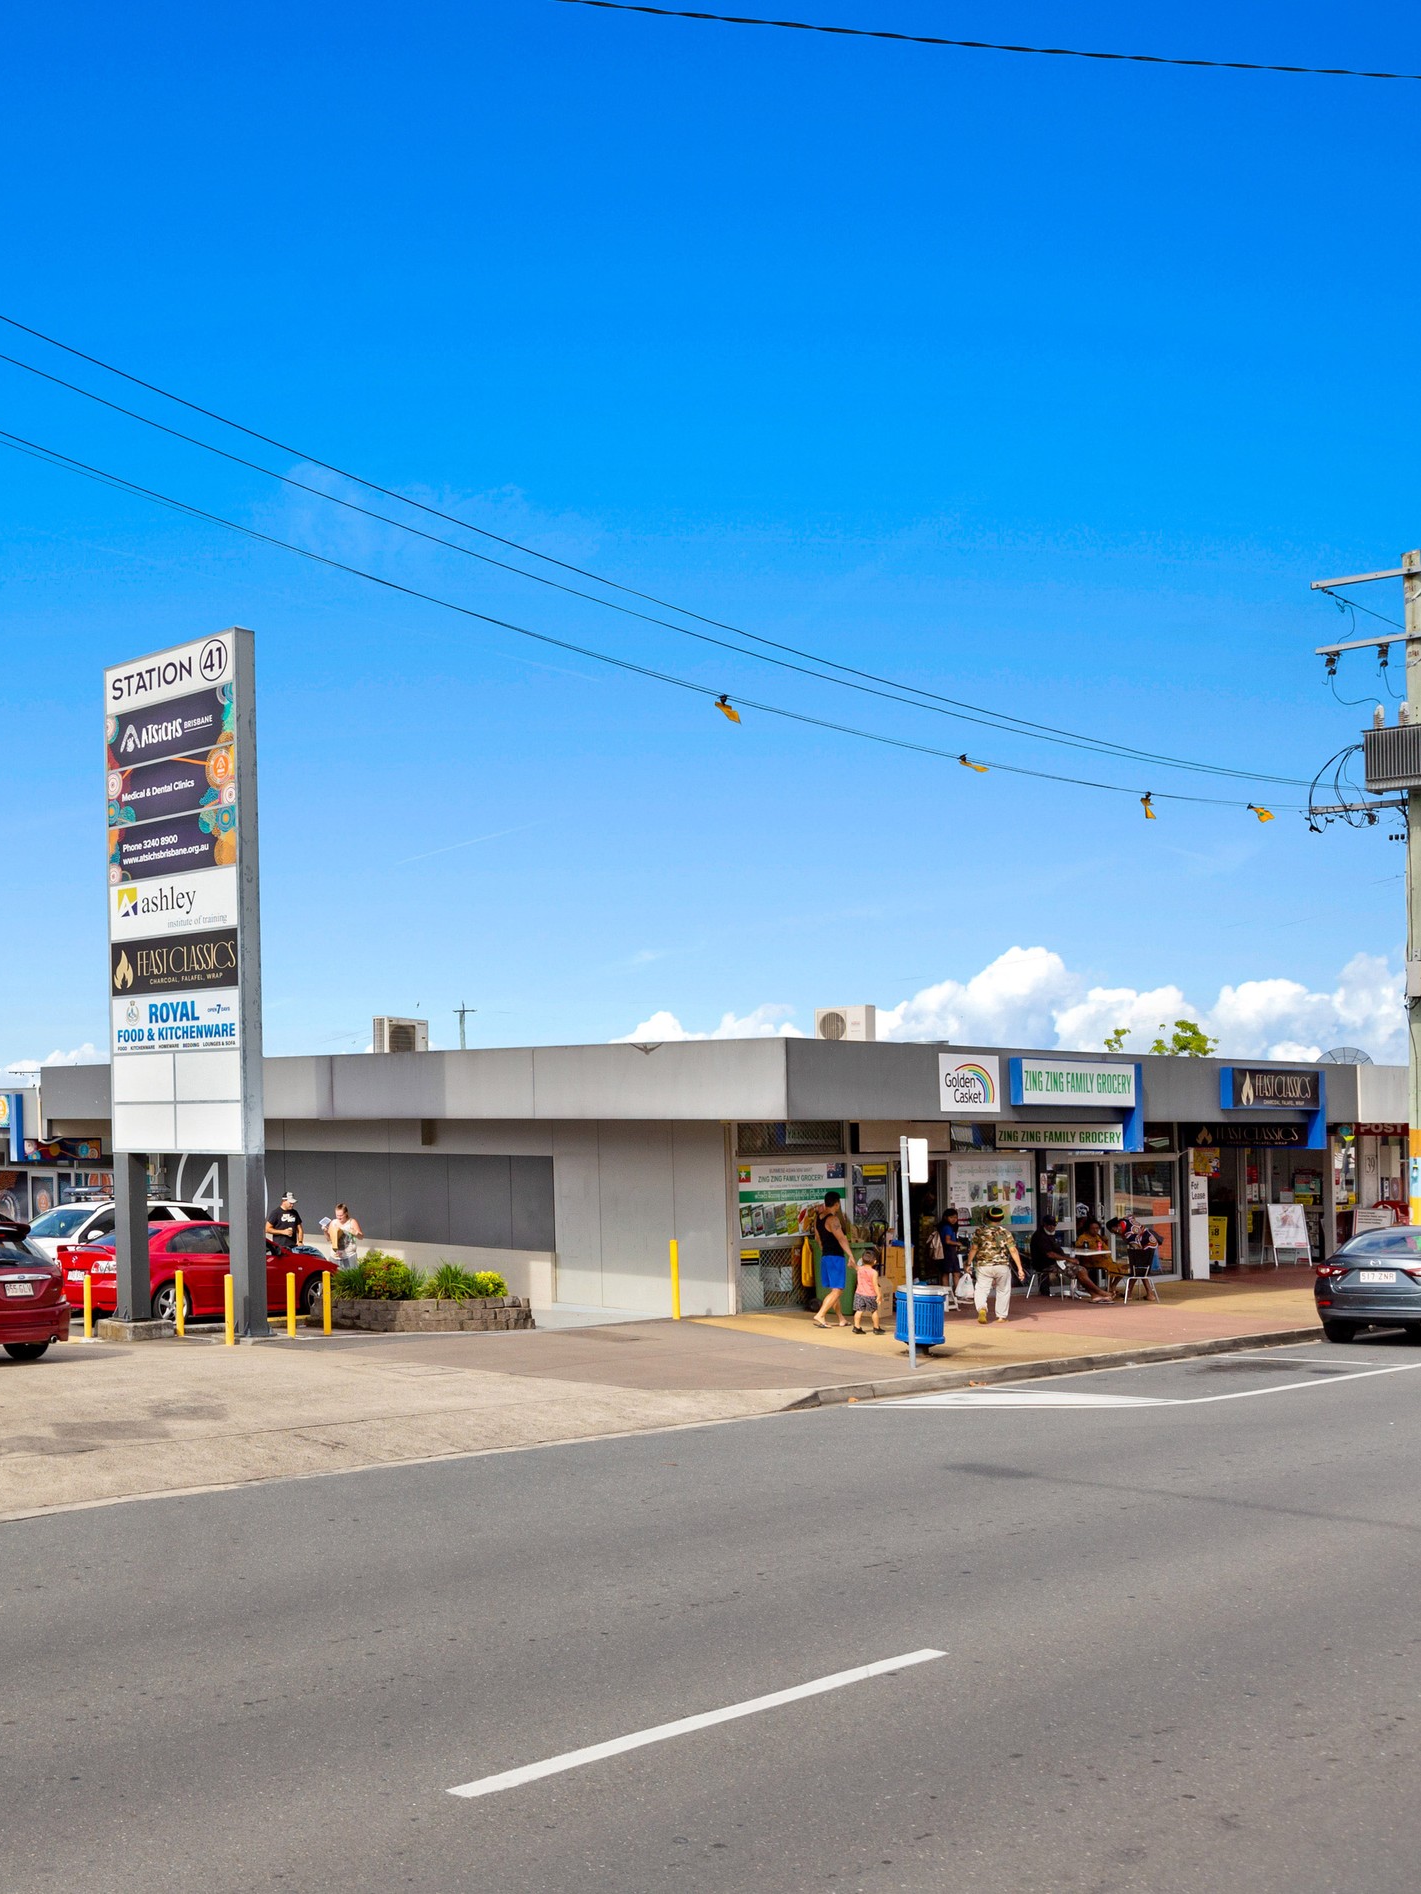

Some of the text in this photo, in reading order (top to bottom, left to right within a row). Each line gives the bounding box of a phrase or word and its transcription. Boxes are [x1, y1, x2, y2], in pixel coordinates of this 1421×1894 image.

[112, 646, 223, 701] STATION 41
[184, 714, 213, 729] BRISBANE
[121, 779, 195, 802] Medical & Dental Clinics
[122, 834, 178, 853] Phone 3240 8900
[122, 843, 210, 865] www.atsichsbrisbane.org.au
[141, 886, 197, 915] ashley
[167, 913, 228, 928] institute of training
[137, 940, 236, 977] FEAST CLASSICS
[149, 972, 223, 985] CHARCOAL, FALAFEL, WRAP
[149, 1000, 200, 1024] ROYAL
[216, 1003, 221, 1014] 7
[117, 1022, 236, 1043] FOOD & KITCHENWARE
[945, 1072, 976, 1088] Golden
[1024, 1070, 1132, 1095] ZING ZING FAMILY GROCERY
[1255, 1074, 1311, 1098] FEAST CLASSICS
[954, 1088, 982, 1104] Casket
[1243, 1126, 1299, 1141] CLASSICS
[1360, 1123, 1404, 1133] POST
[998, 1130, 1122, 1144] ZING ZING FAMILY GROCERY
[1366, 1157, 1376, 1174] 39
[758, 1173, 824, 1183] ZING ZING FAMILY GROCERY
[1191, 1181, 1199, 1190] For
[1191, 1191, 1206, 1200] Lease
[1361, 1272, 1375, 1280] 517
